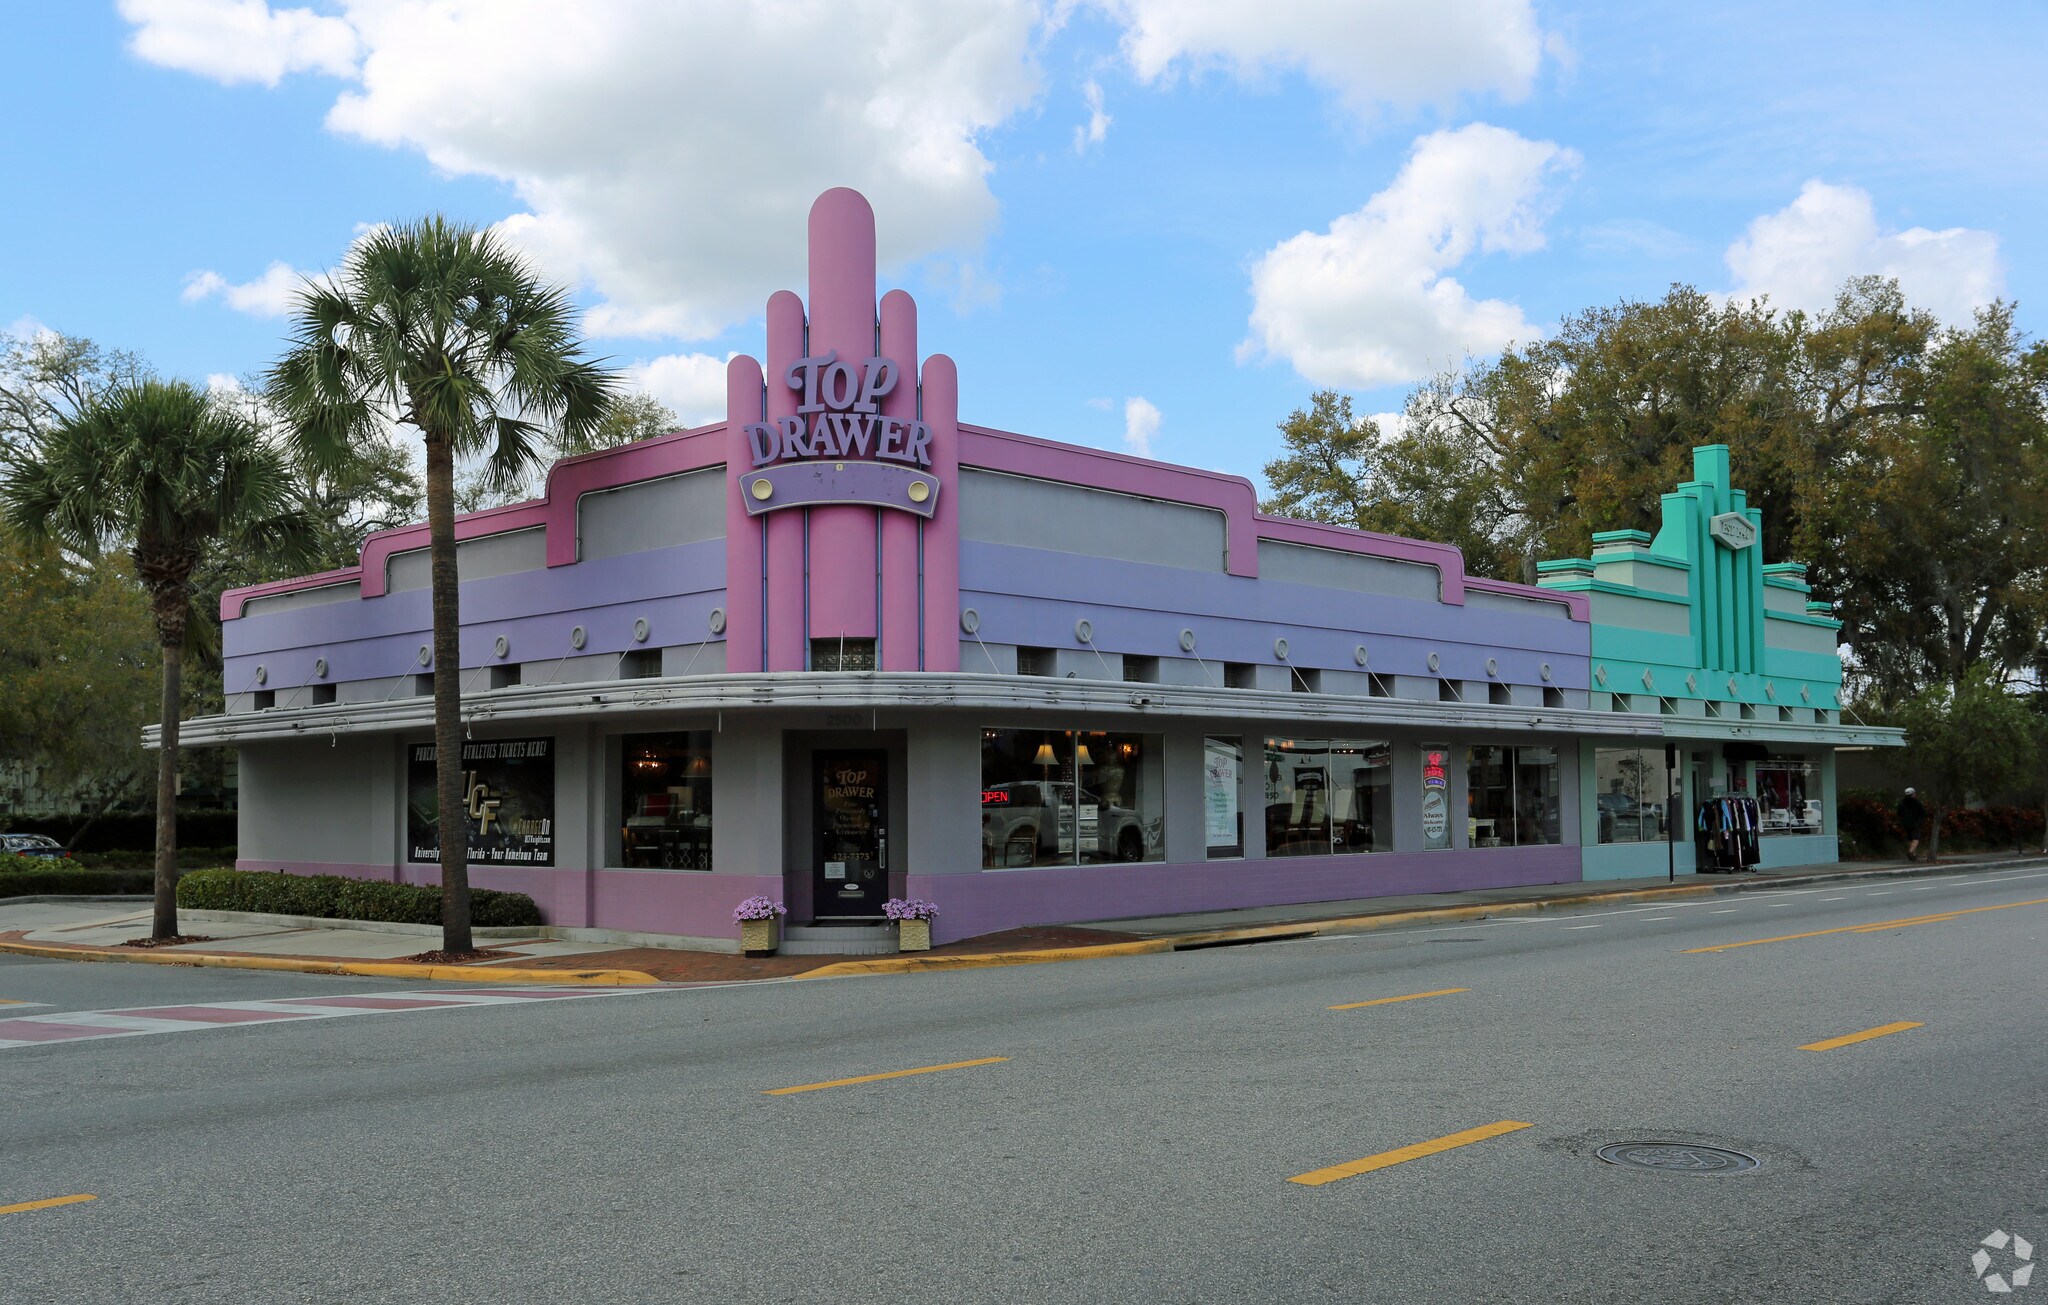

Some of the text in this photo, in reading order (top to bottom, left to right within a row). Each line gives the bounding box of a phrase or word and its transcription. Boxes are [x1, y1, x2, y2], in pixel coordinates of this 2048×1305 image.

[785, 349, 899, 414] TOP
[743, 411, 934, 467] DRAWER
[463, 744, 496, 759] ATHLETICS
[499, 743, 525, 758] TICKETS
[527, 741, 547, 756] HERE!
[836, 769, 867, 785] TOP
[828, 786, 875, 799] DRAWER
[981, 791, 1008, 803] OPEN
[461, 770, 500, 835] UCF
[414, 846, 440, 861] University
[466, 847, 485, 860] Florida
[491, 847, 504, 860] Your
[504, 847, 532, 860] Hometown
[533, 848, 548, 861] Team
